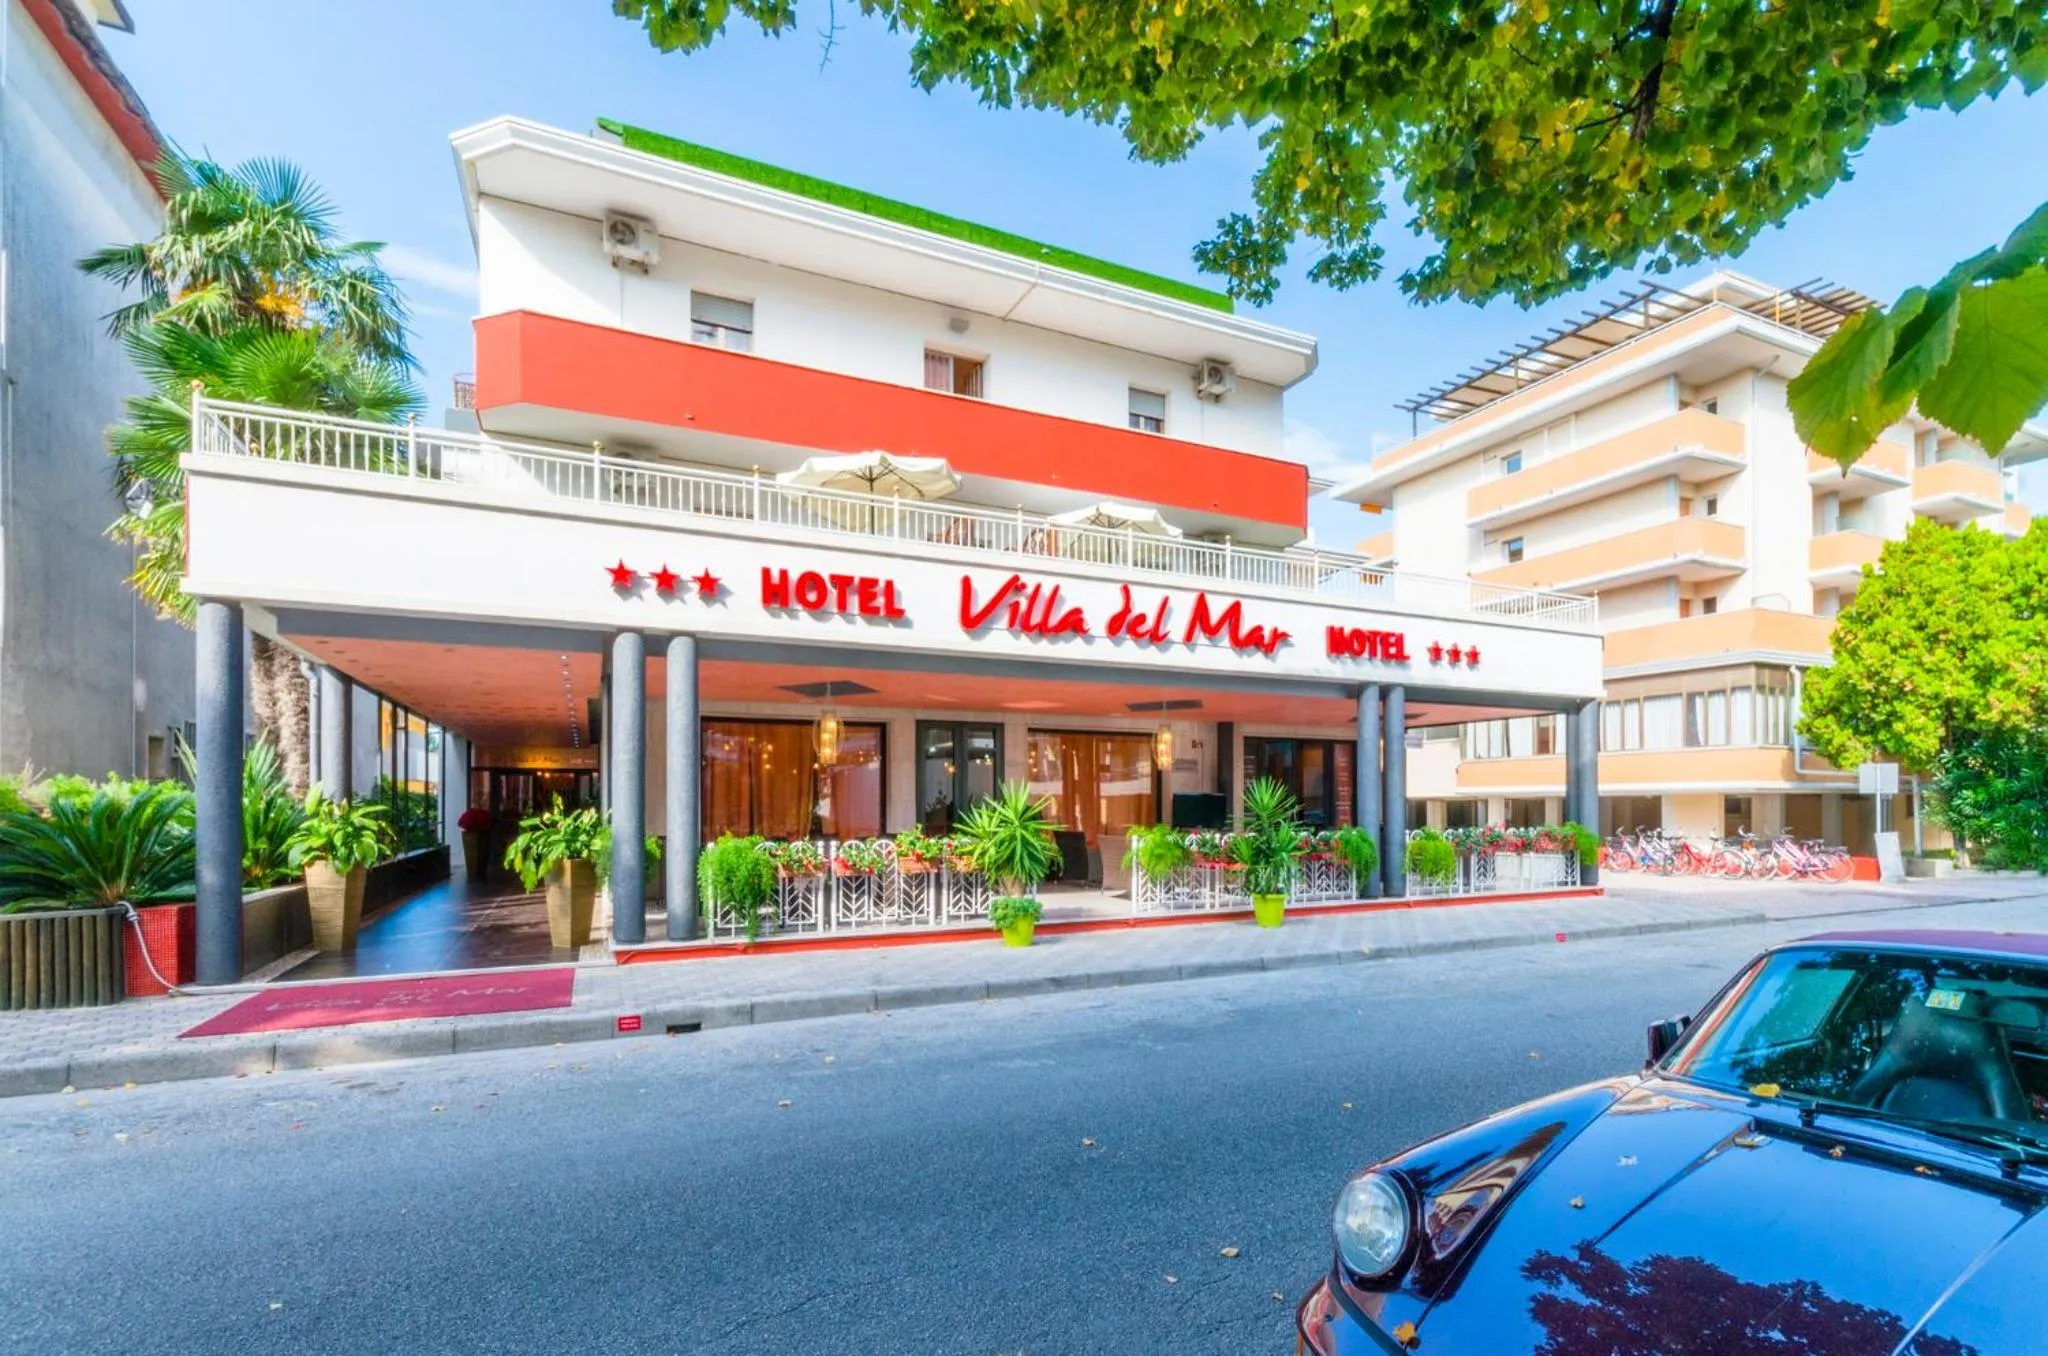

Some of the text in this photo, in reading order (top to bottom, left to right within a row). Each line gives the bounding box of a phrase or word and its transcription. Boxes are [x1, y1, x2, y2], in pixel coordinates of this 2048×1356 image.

[762, 567, 905, 619] HOTEL
[960, 574, 1090, 637] Villa
[1107, 584, 1169, 644] del
[1185, 592, 1293, 654] Mar
